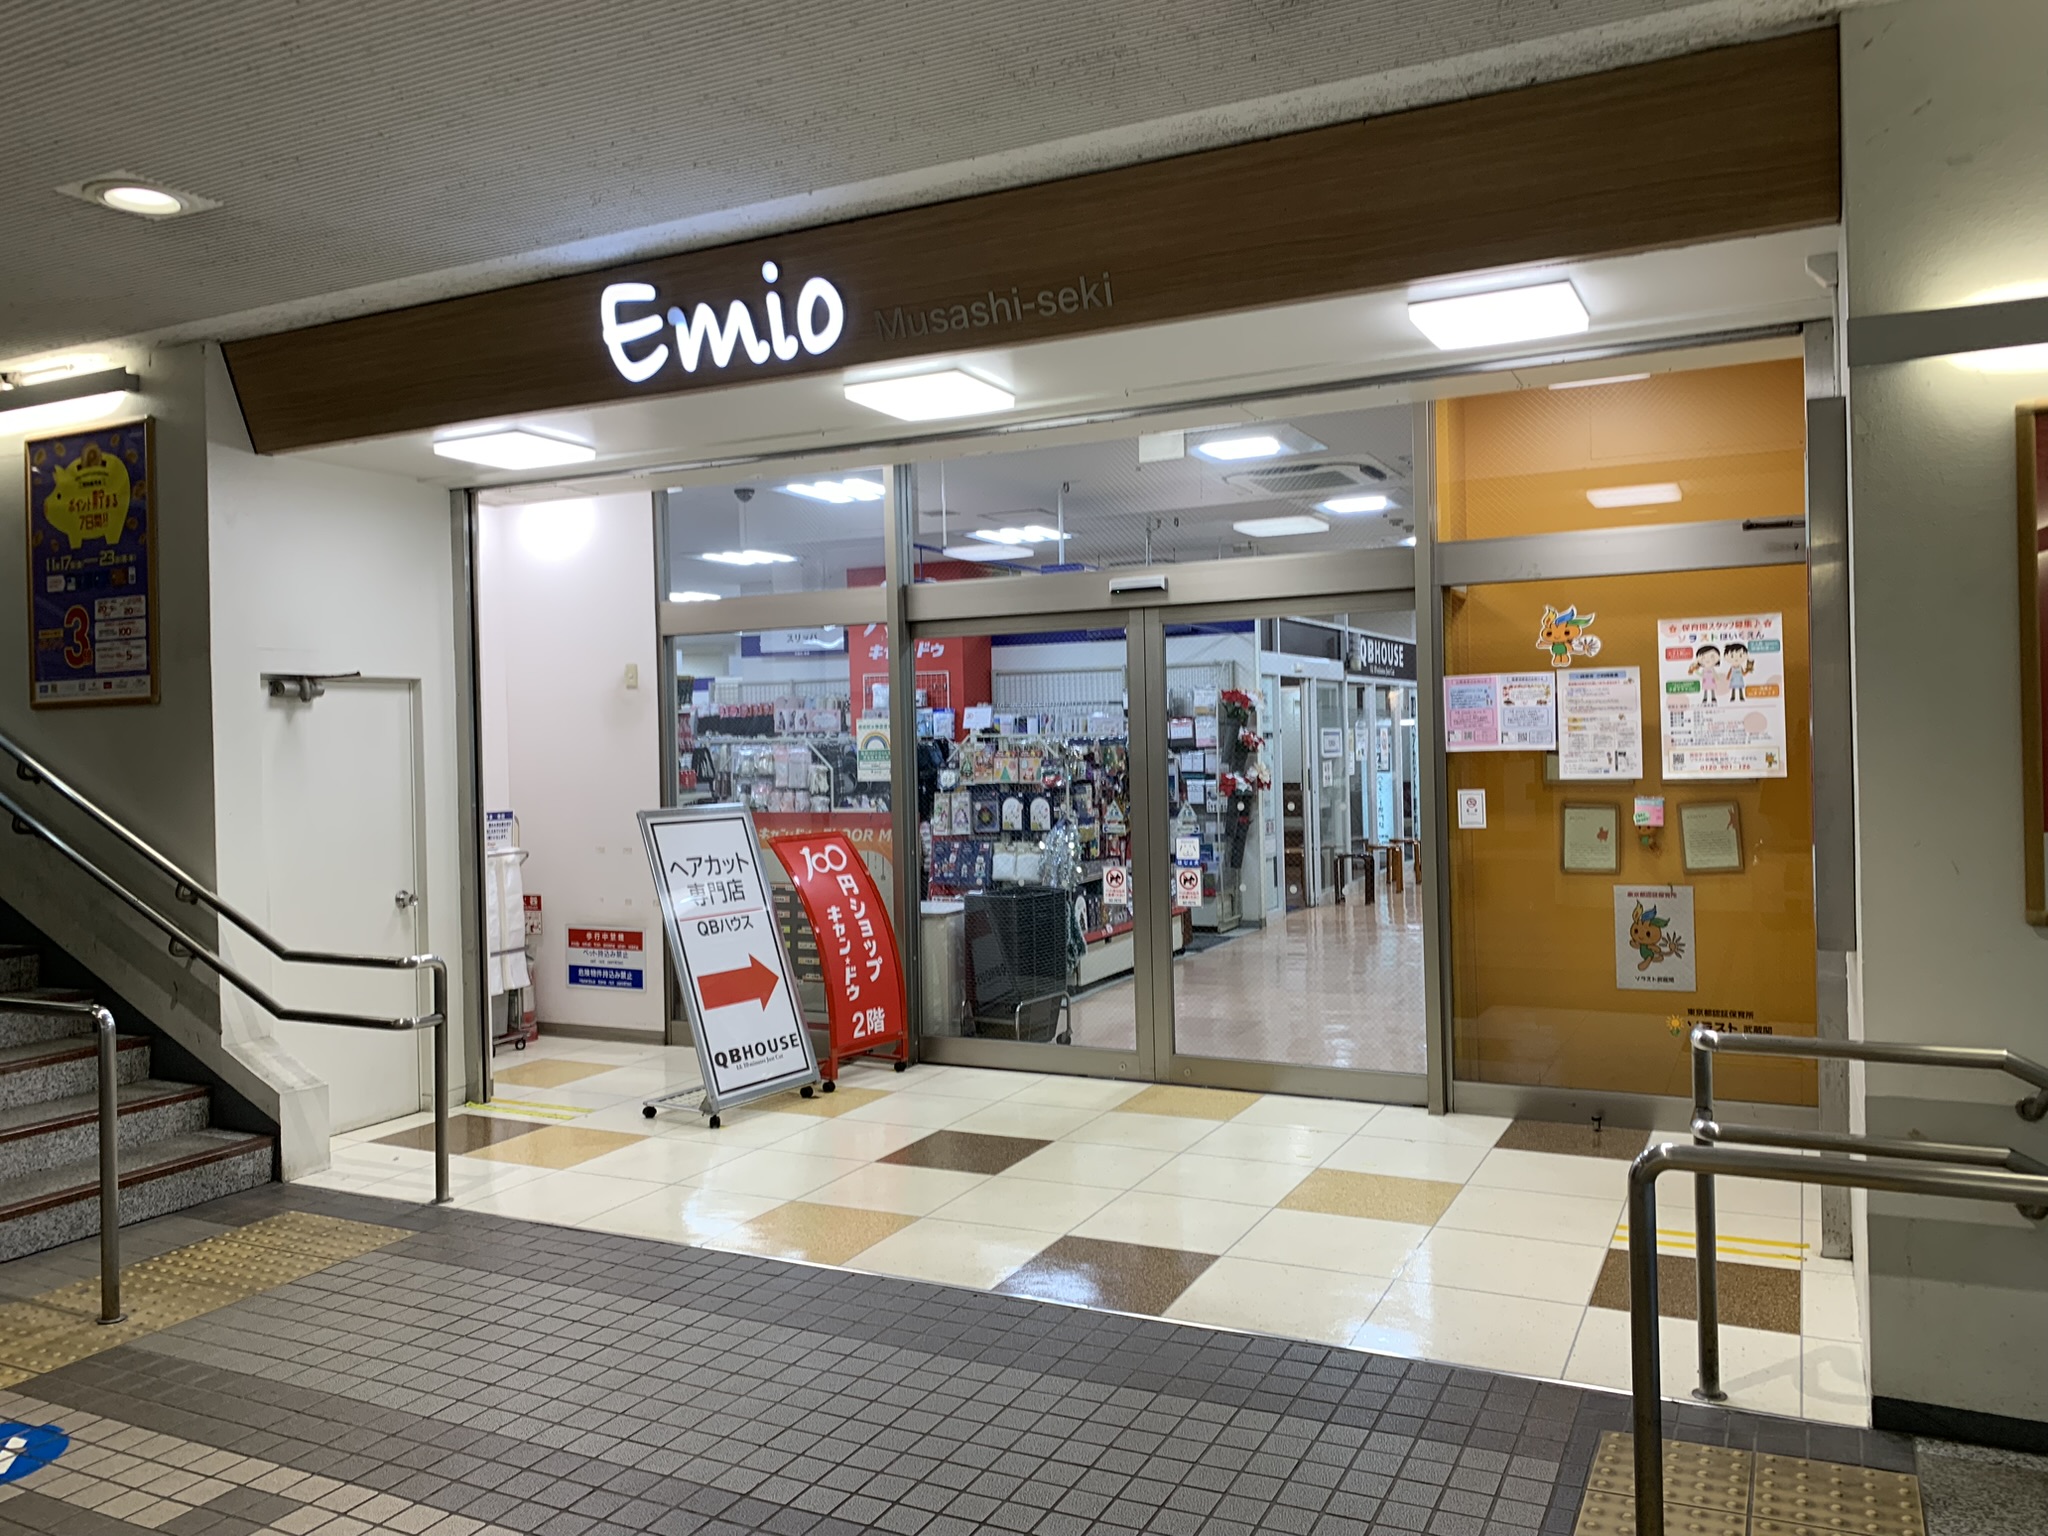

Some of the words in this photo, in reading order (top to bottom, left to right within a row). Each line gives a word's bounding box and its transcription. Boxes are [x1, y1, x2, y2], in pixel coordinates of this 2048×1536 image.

[601, 261, 845, 383] Emio
[874, 271, 1114, 342] Musashi-seki
[670, 852, 749, 880] ヘアカット
[686, 879, 746, 908] 専門店
[697, 914, 754, 937] QBハウス
[851, 1007, 885, 1039] 2階
[714, 1033, 800, 1069] QBHOUSE
